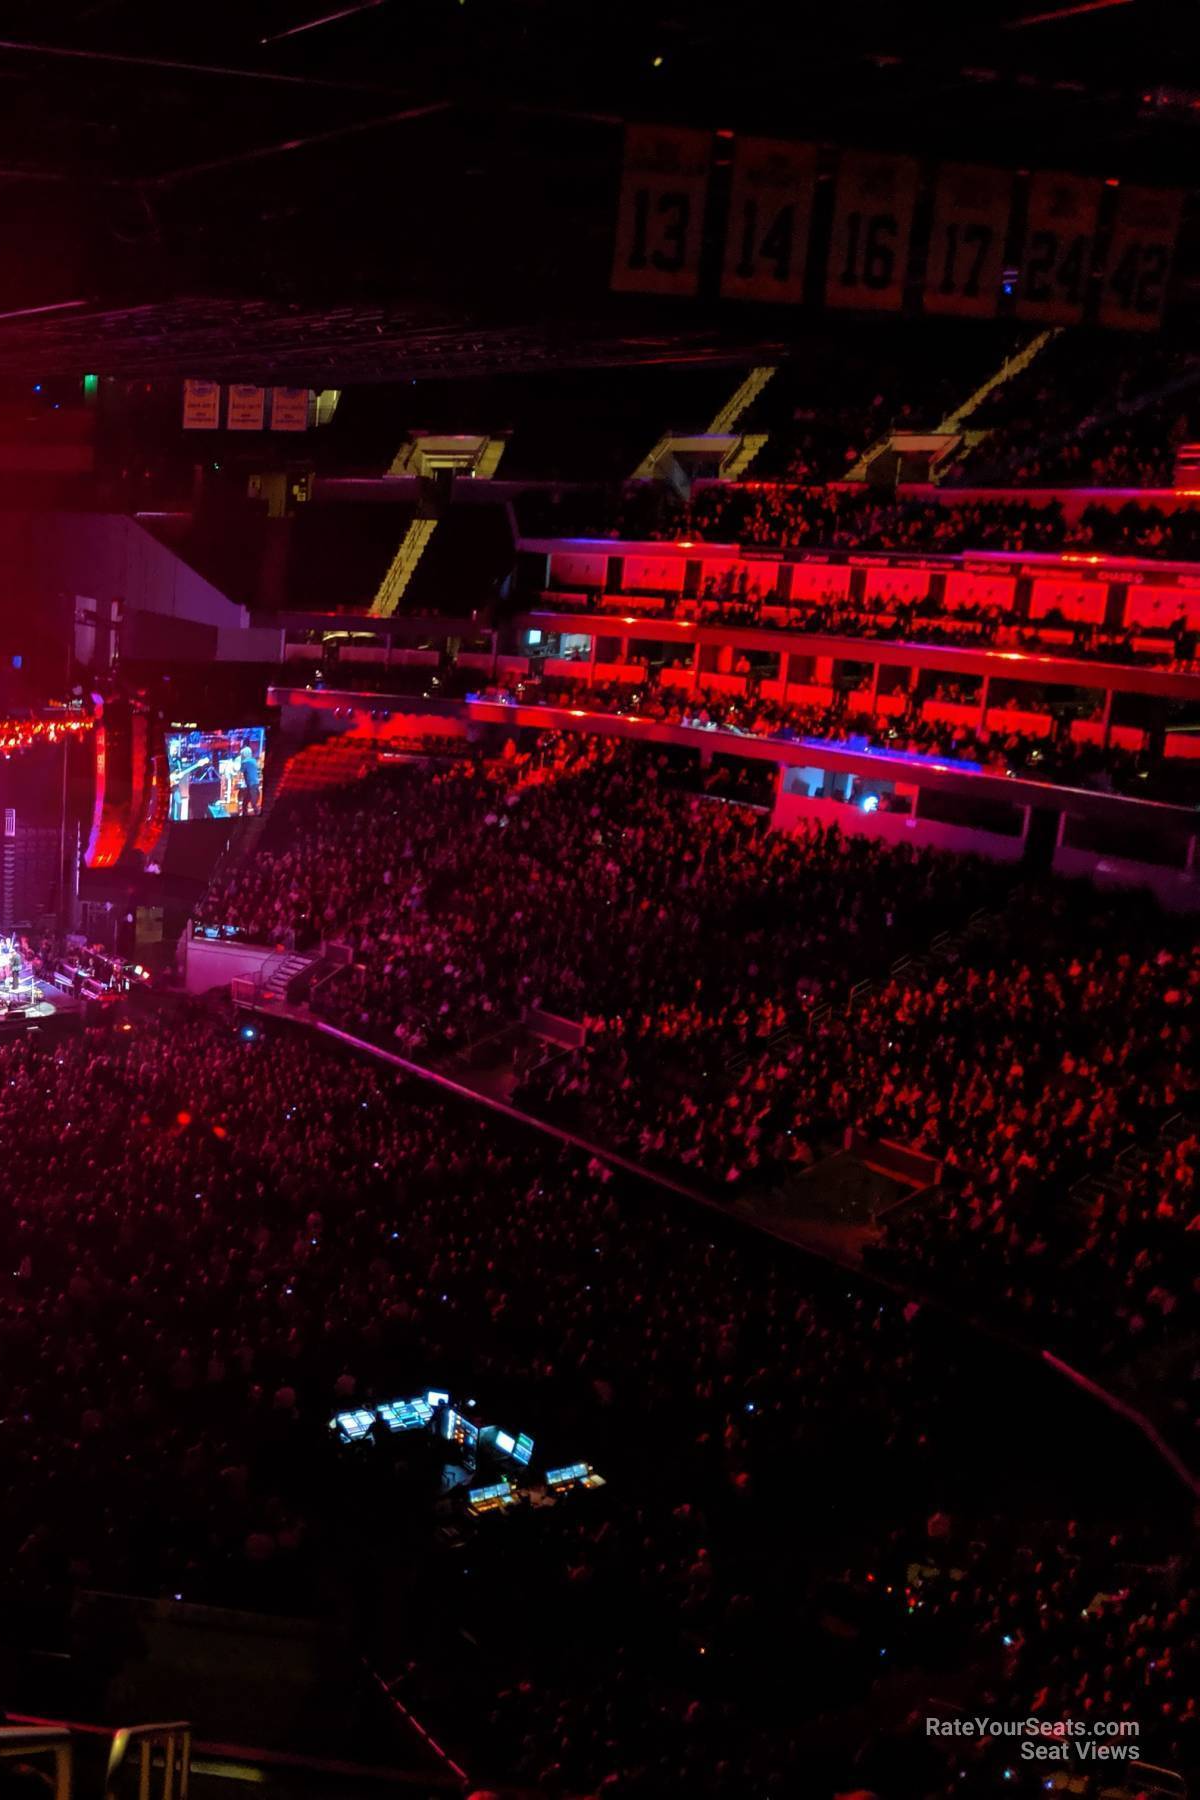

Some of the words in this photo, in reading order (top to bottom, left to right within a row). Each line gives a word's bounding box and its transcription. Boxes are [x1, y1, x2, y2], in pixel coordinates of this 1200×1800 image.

[632, 187, 690, 270] 13
[741, 199, 794, 278] 14
[840, 211, 897, 289] 16
[941, 222, 993, 298] 17
[1023, 232, 1082, 303] 24
[1108, 244, 1169, 313] 42
